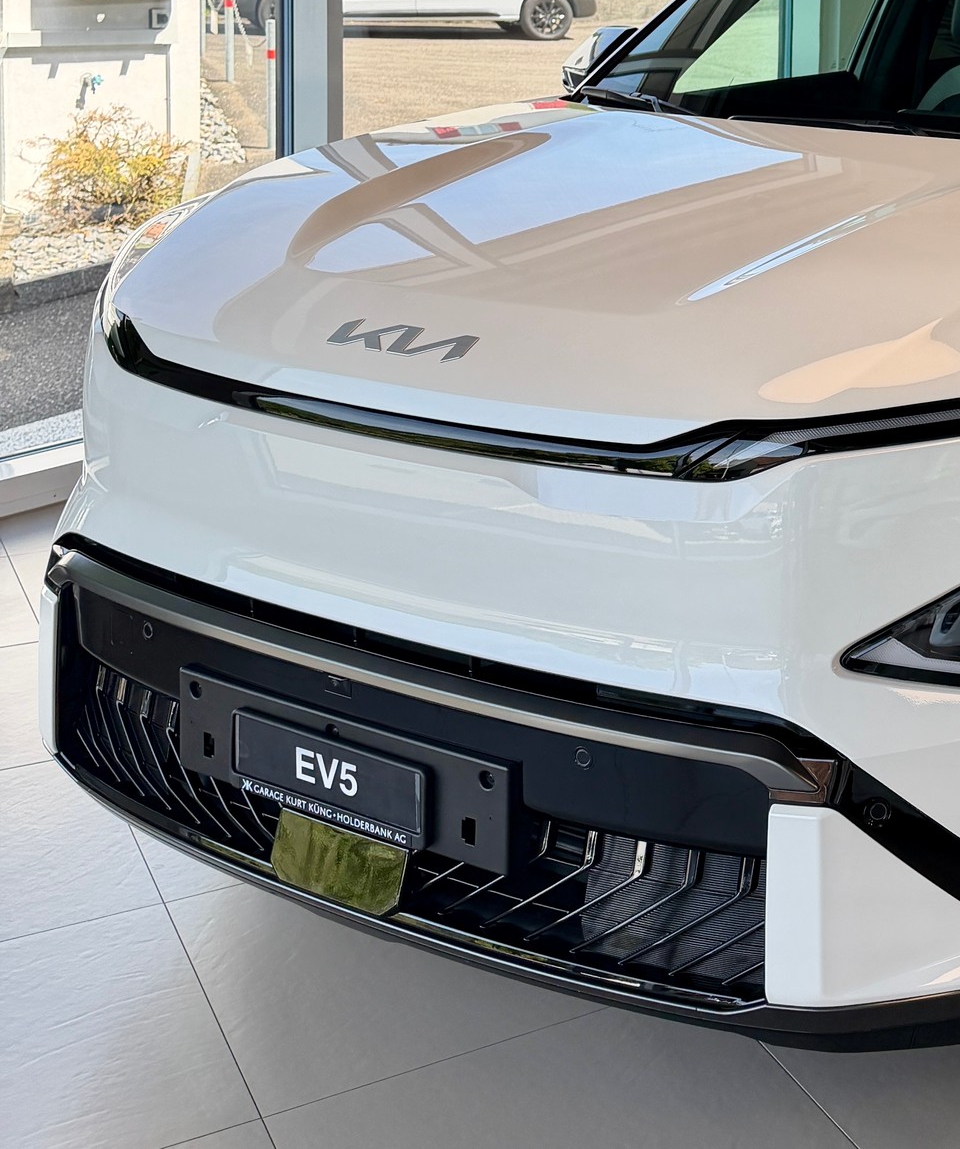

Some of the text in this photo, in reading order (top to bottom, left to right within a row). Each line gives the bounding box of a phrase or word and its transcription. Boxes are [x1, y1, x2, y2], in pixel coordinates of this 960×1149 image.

[295, 746, 358, 797] EV5
[254, 784, 284, 802] GARAGE
[286, 794, 307, 810] KURT
[308, 800, 332, 818] KÜNG
[336, 813, 392, 838] HOLDERBANK
[394, 832, 407, 844] AG
